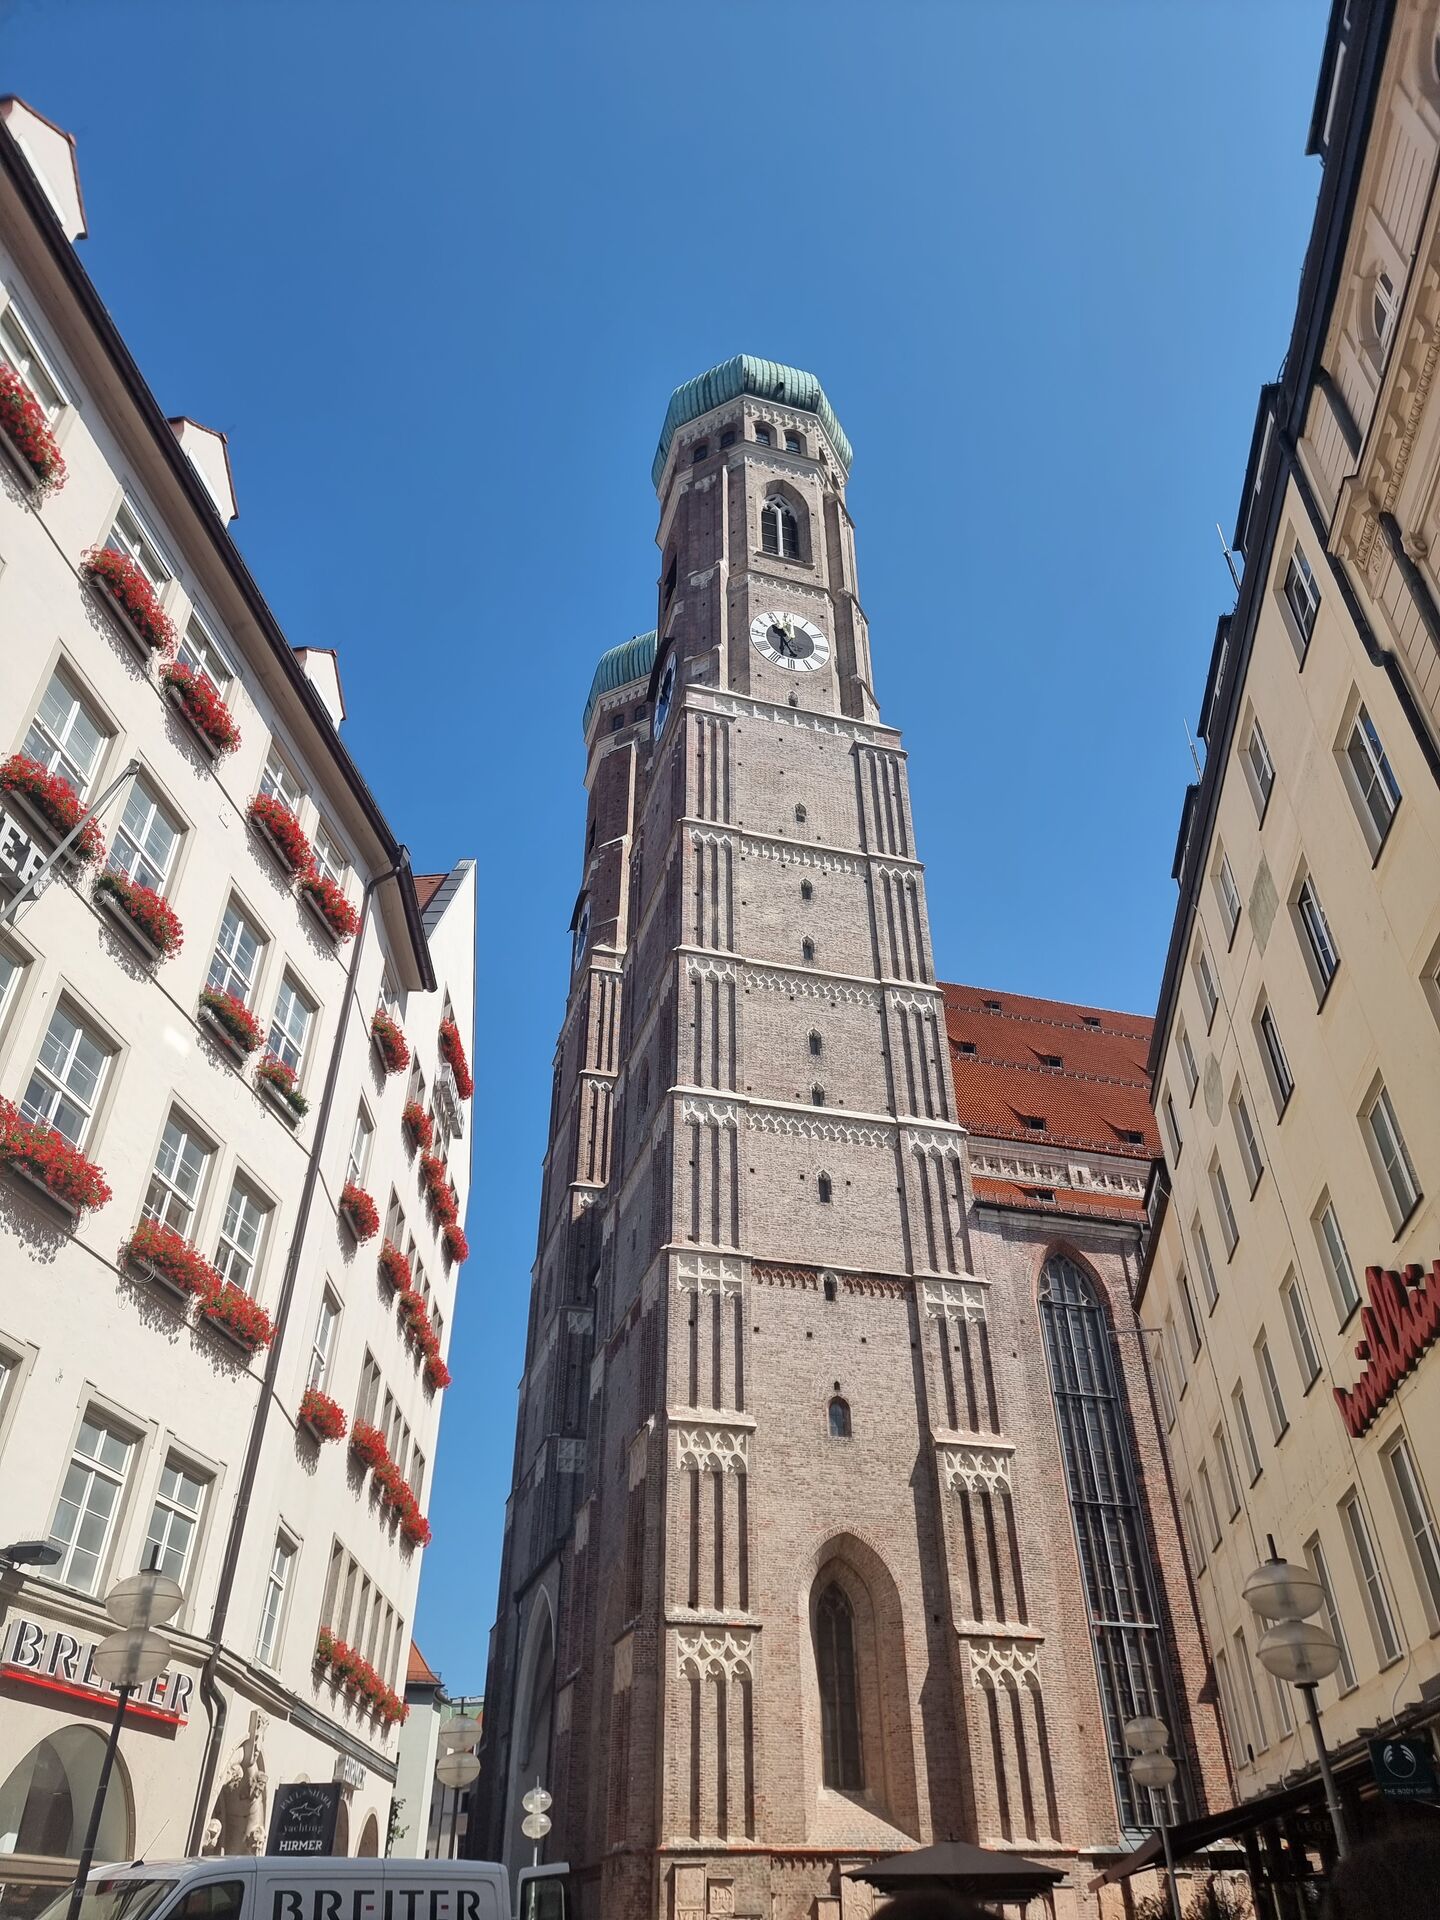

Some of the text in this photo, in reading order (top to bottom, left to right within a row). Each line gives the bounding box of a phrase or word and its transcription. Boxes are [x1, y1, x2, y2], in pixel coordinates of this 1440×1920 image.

[283, 1822, 323, 1835] yachting
[279, 1840, 323, 1851] HIRMER
[272, 1889, 481, 1920] BREITER
